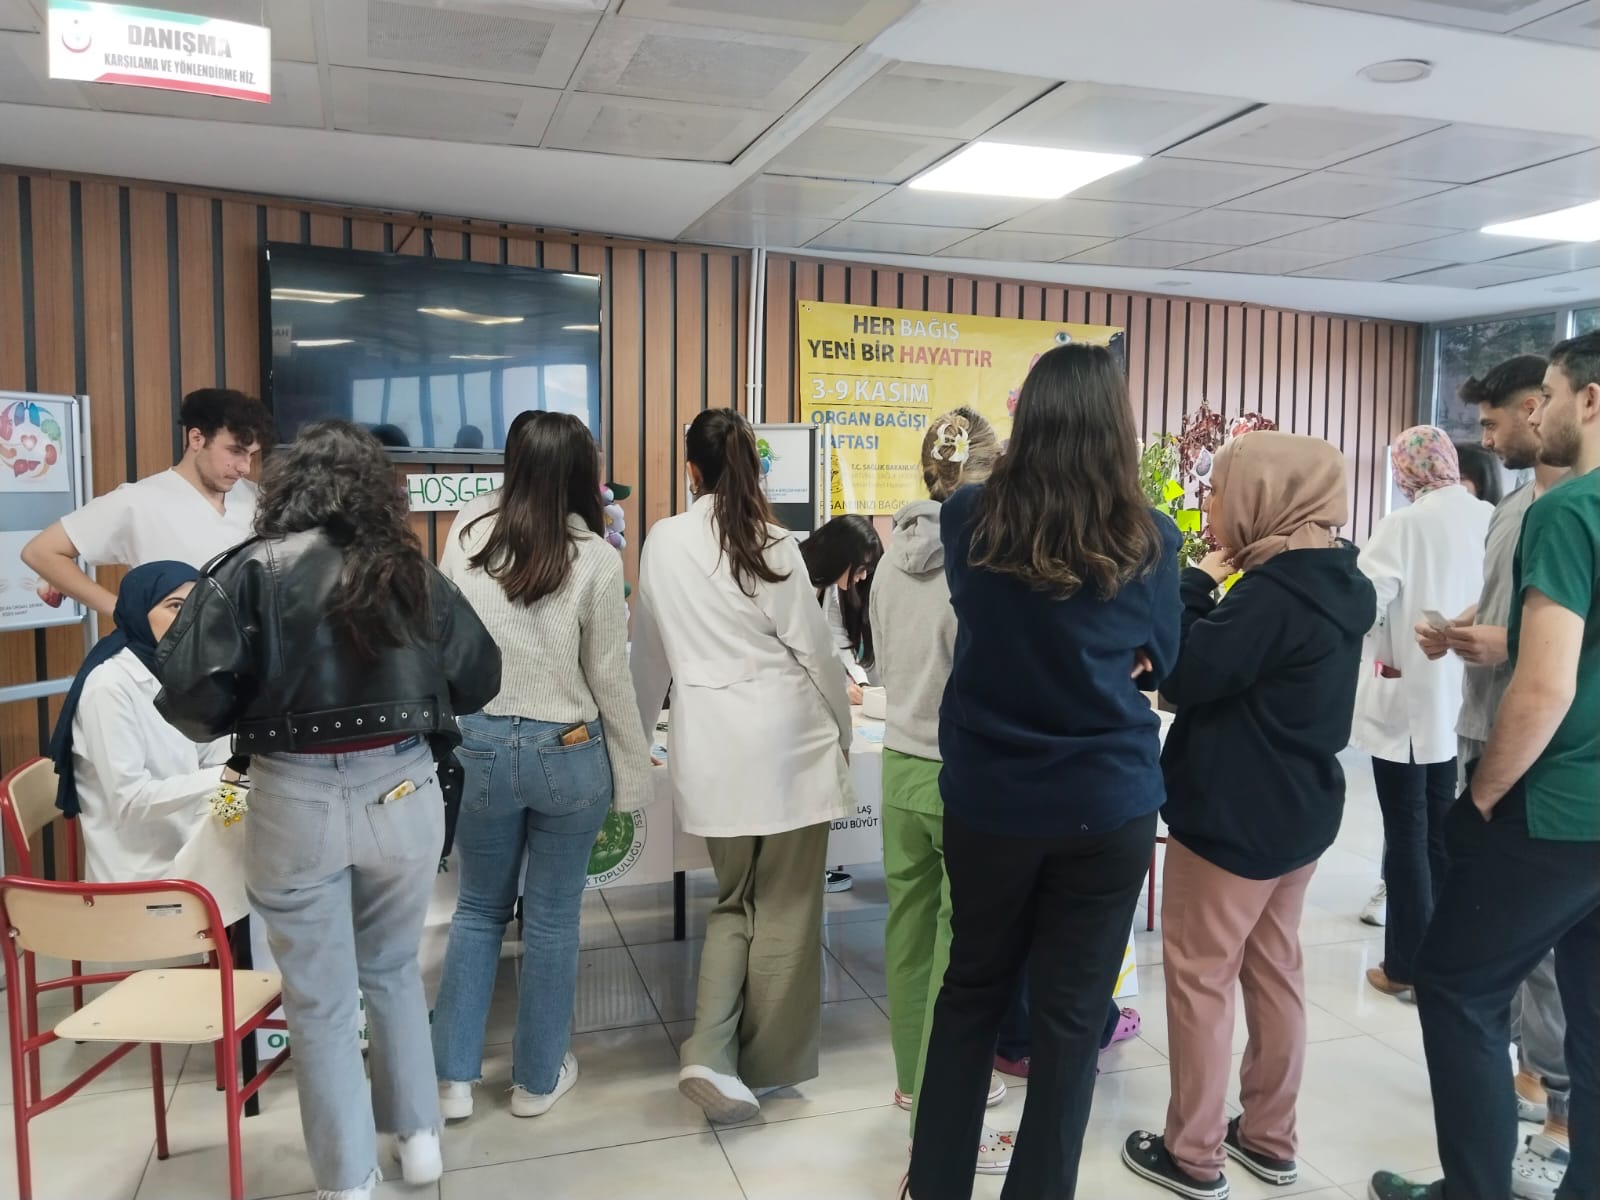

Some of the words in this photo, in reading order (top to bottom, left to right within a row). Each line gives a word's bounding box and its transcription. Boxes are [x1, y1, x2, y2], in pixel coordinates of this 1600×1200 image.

[127, 24, 232, 58] DANIŞMA
[104, 53, 159, 72] KARŞILAMA
[160, 59, 173, 73] VE
[174, 60, 238, 82] YÖNLENDİRME
[239, 70, 256, 85] HİZ.
[853, 314, 895, 336] HER
[900, 317, 960, 343] BAĞIŞ
[807, 338, 856, 361] YENİ
[861, 340, 895, 363] BİR
[899, 345, 992, 368] HAYATTIR
[811, 378, 849, 401] 3-9
[855, 380, 929, 404] KASIM
[811, 410, 871, 427] ORGAN
[874, 410, 927, 432] BAĞIŞI
[857, 805, 872, 815] LAŞ
[830, 821, 848, 831] UDU
